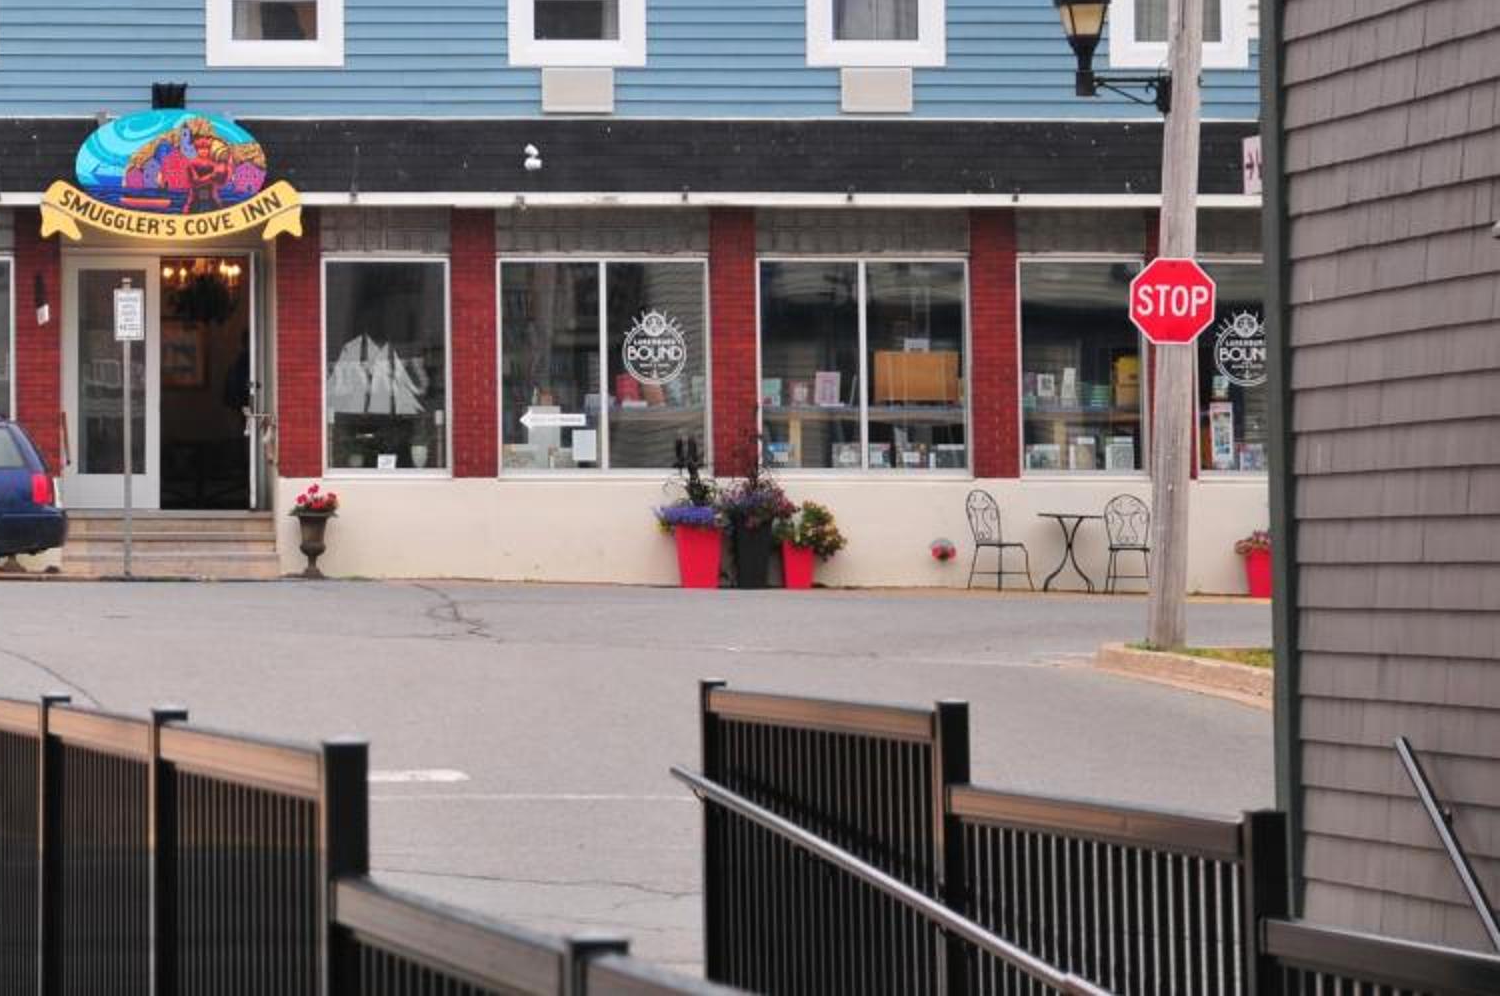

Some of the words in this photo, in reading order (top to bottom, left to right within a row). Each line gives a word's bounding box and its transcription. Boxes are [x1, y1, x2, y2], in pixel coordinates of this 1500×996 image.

[59, 190, 176, 235] SMUGGLER'S
[184, 212, 234, 237] COVE
[241, 191, 283, 224] INN
[1136, 283, 1209, 317] STOP
[628, 346, 682, 361] BOUND
[1219, 347, 1267, 361] BOUN
